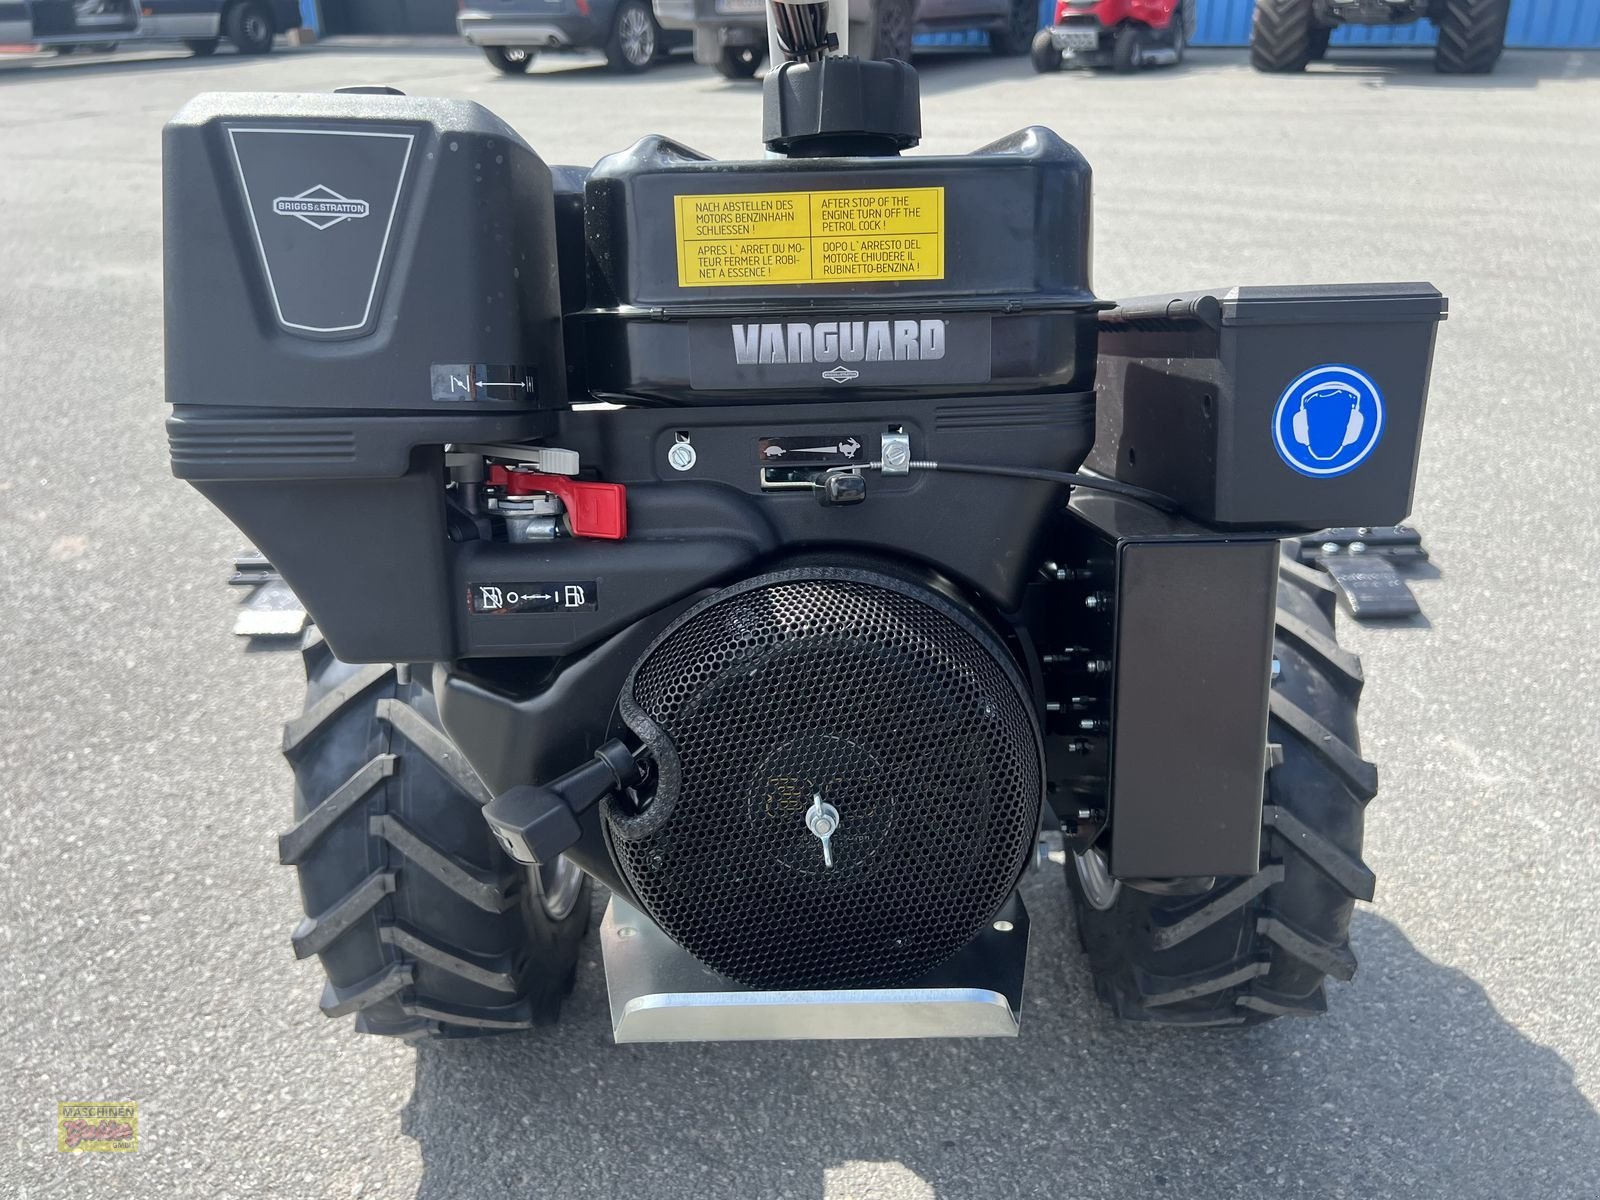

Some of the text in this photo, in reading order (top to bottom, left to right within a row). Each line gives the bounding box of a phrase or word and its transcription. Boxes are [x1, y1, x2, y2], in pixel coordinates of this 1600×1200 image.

[695, 200, 794, 212] NACH ABSTELLEN DES
[821, 196, 909, 208] AFTER STOP OF THE
[696, 211, 795, 224] MOTORS BENZINHAHN
[822, 207, 921, 220] ENGINE TURN OFF THE
[696, 224, 750, 235] SCHLIESSEN
[822, 221, 856, 232] PETROL
[858, 220, 881, 231] COCK
[698, 245, 727, 255] APRES
[740, 244, 770, 254] ARRET
[772, 243, 785, 253] DU
[788, 243, 805, 253] MO-
[823, 241, 848, 252] DOPO
[860, 240, 902, 250] ARRESTO
[904, 239, 920, 249] DEL
[698, 255, 800, 267] TEUR FERMER LE ROBI-
[823, 251, 915, 263] MOTORE CHIUDERE IL
[699, 268, 716, 278] NET
[719, 268, 726, 277] A
[727, 267, 766, 277] ESSENCE
[823, 262, 915, 275] RUBINETTO-BENZINA
[731, 319, 946, 365] VANGUARD
